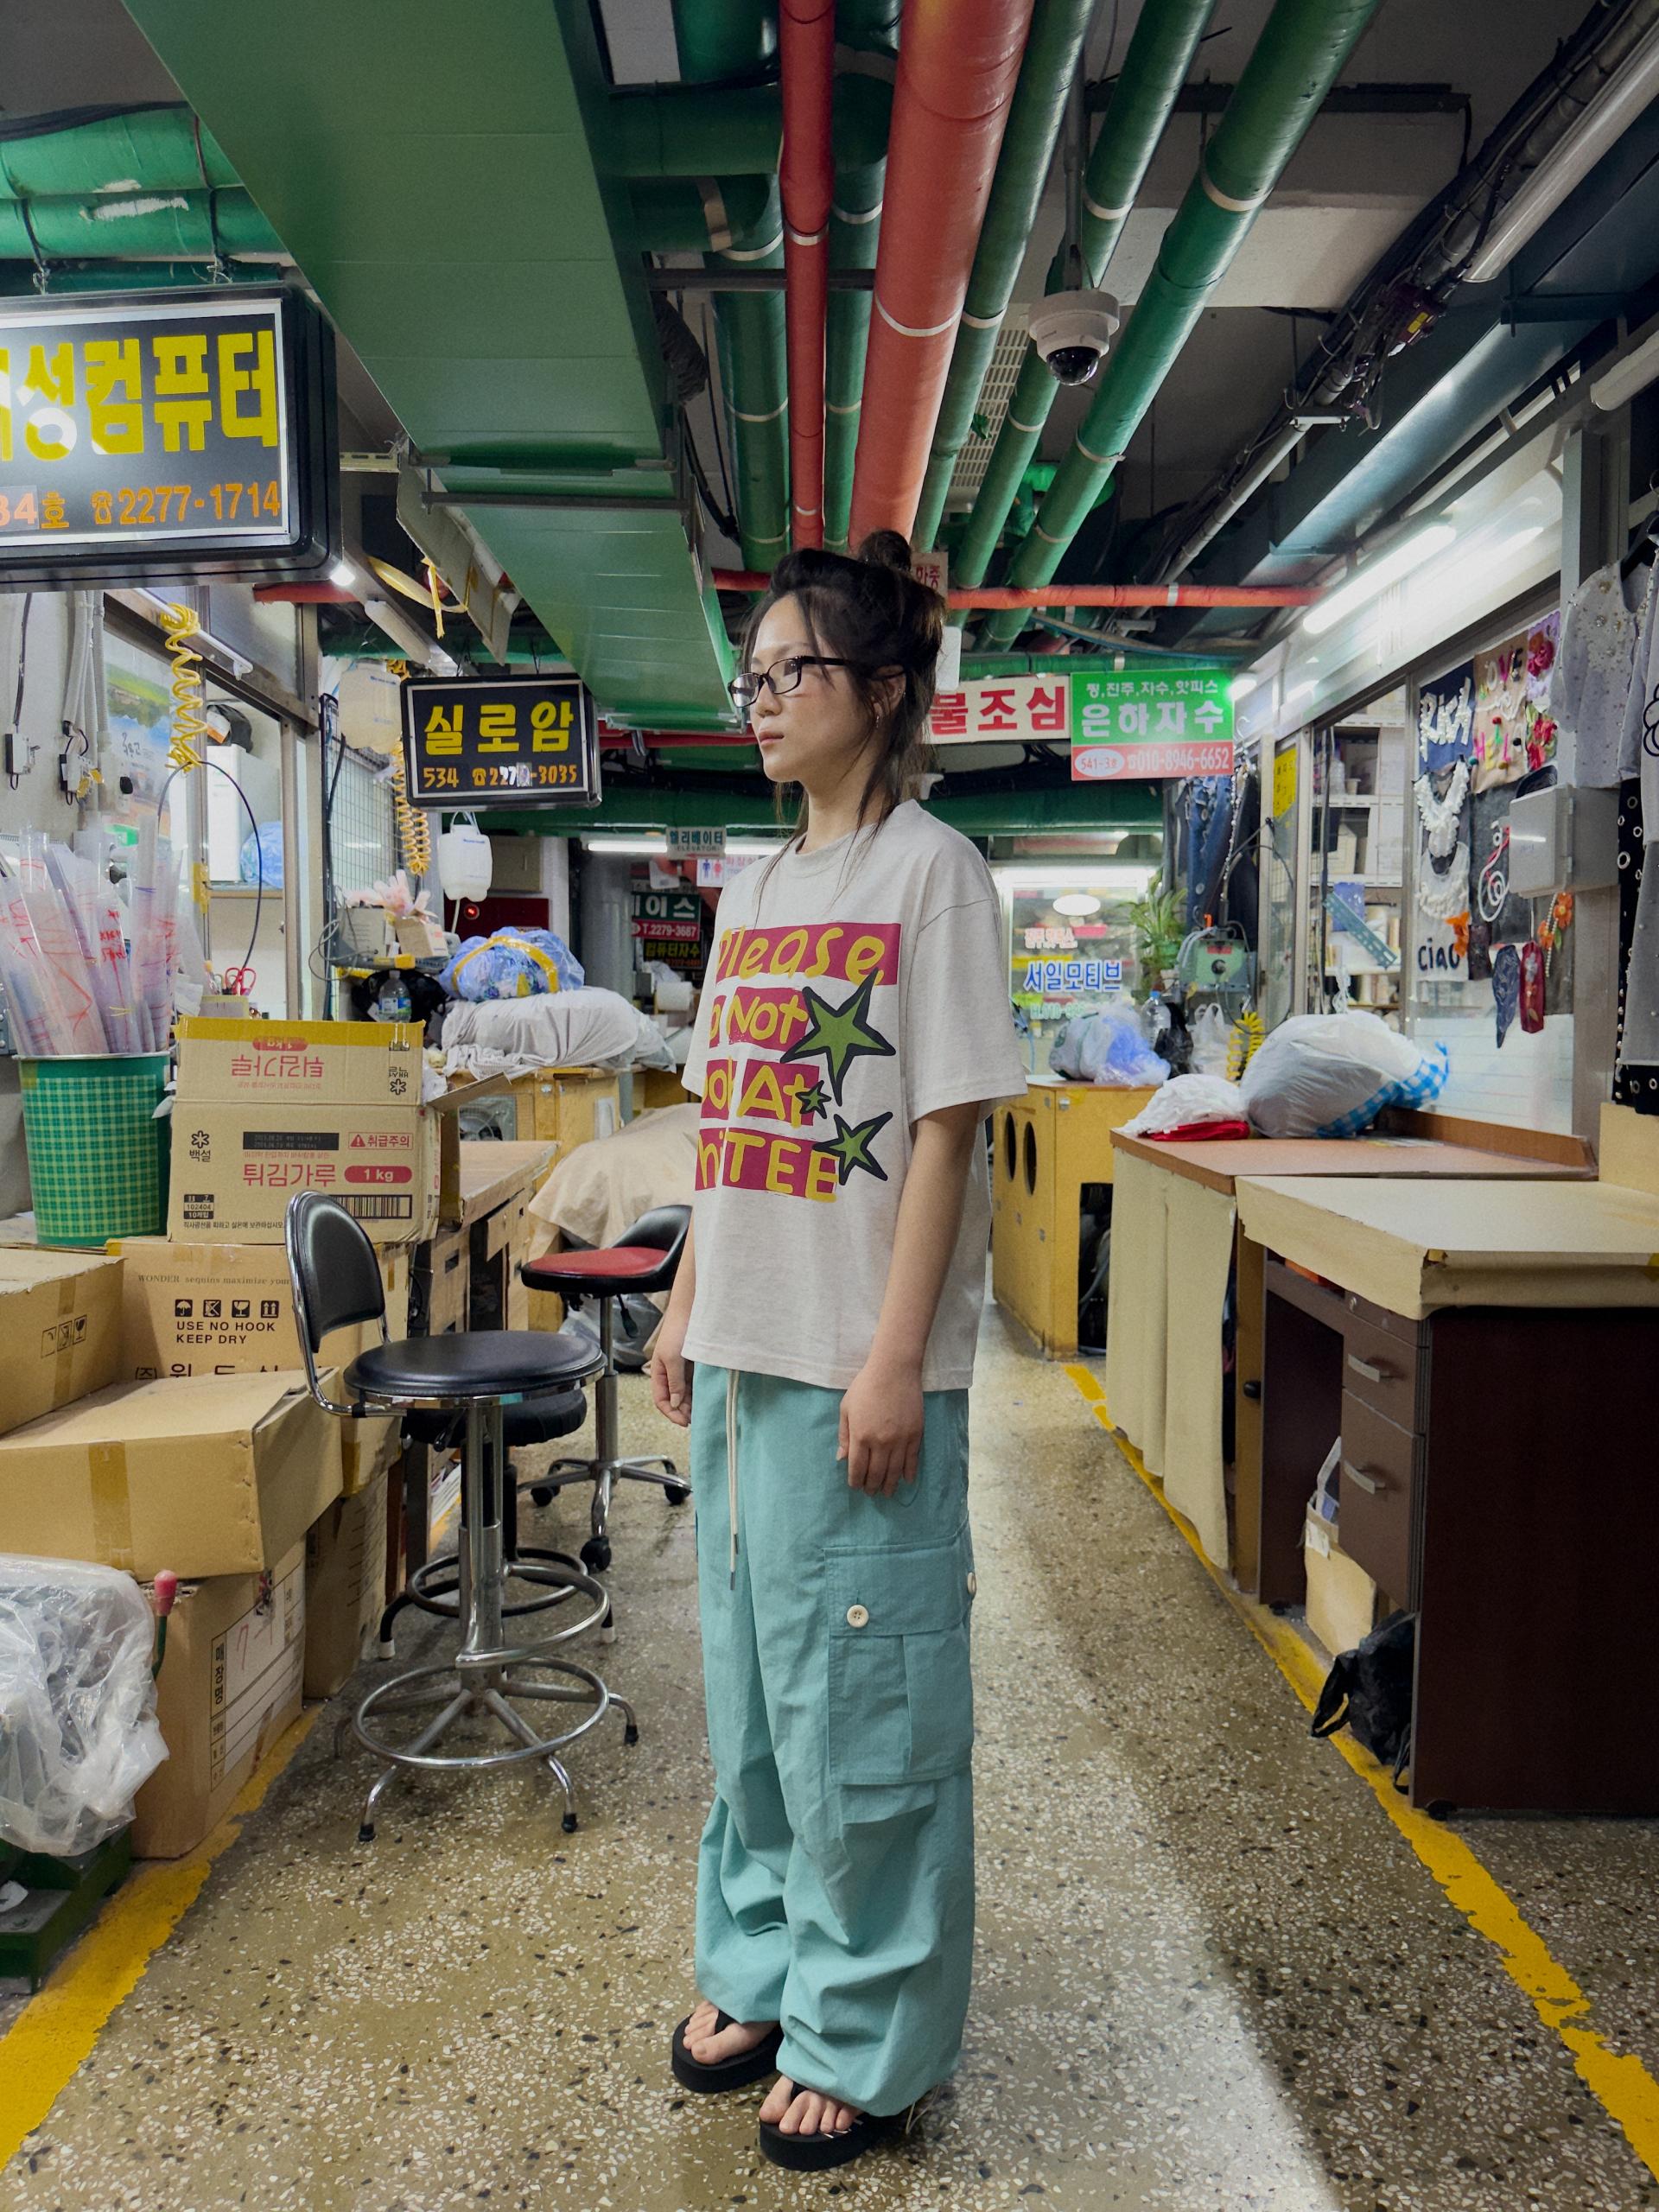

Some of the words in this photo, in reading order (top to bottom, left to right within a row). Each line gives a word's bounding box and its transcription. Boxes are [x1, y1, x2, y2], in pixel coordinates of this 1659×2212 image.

[118, 481, 281, 525] 2277-1714
[423, 700, 575, 756] 실로암
[1081, 700, 1224, 738] 은하자수
[423, 766, 460, 789] 534
[670, 830, 723, 845] 엘리베이터
[727, 995, 809, 1045] Not
[736, 1065, 806, 1129] At
[366, 1135, 410, 1148] 취급주의
[188, 1149, 211, 1162] 백설
[726, 1130, 838, 1204] TEE
[243, 1163, 336, 1187] 튀김가루
[364, 1169, 370, 1180] 1
[376, 1168, 394, 1182] kg
[137, 1274, 180, 1283] WONDER
[176, 1320, 204, 1331] USE
[210, 1321, 229, 1332] NO
[235, 1322, 276, 1332] HOOK
[175, 1333, 213, 1344] KEEP
[219, 1334, 247, 1344] DRY
